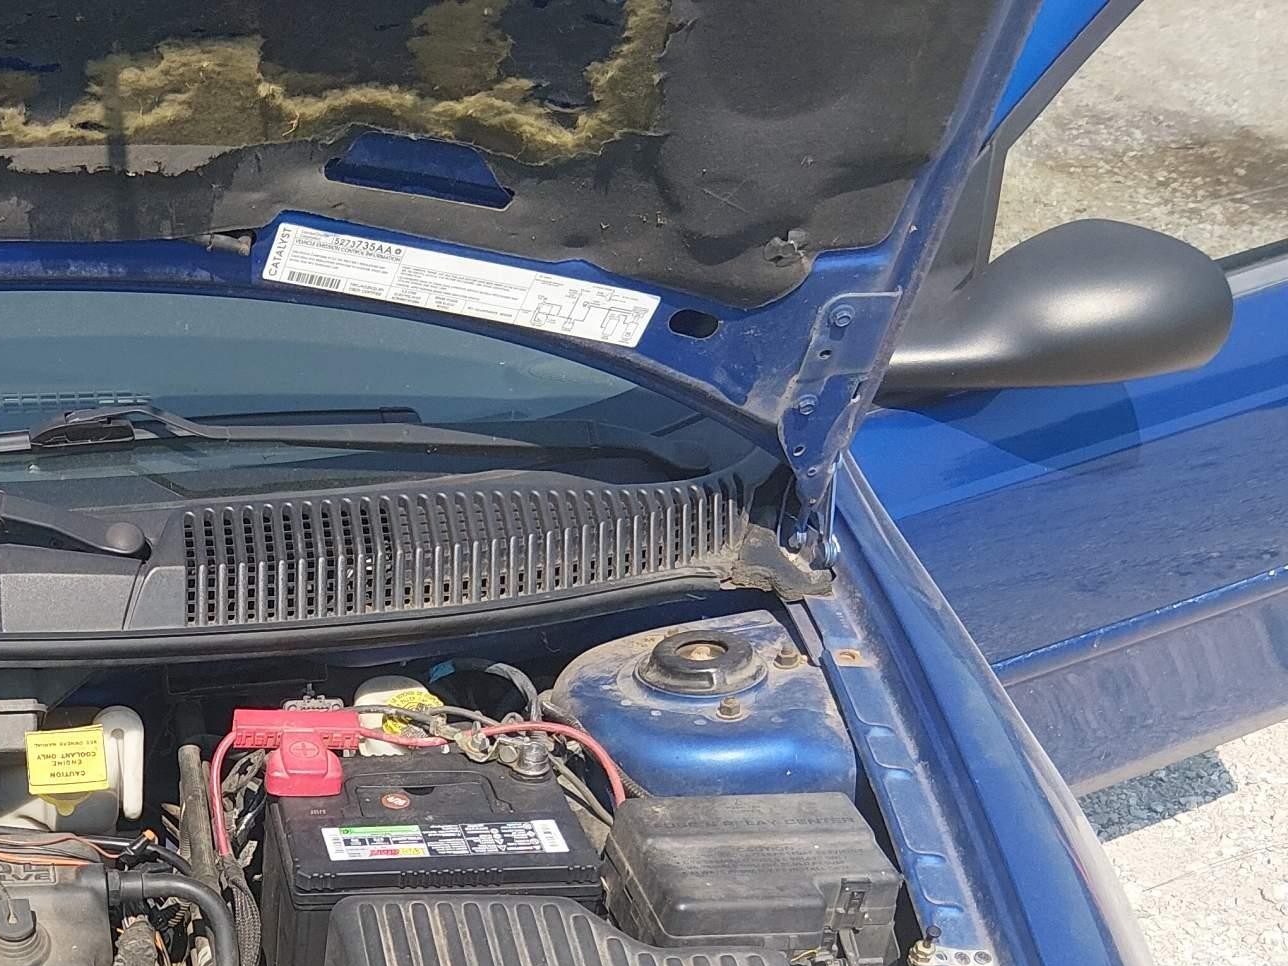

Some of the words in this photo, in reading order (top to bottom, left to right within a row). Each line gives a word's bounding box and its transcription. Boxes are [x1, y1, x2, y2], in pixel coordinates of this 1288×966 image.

[268, 228, 291, 276] CATALYST
[334, 238, 392, 254] 5273735AA
[50, 770, 86, 778] CAUTION
[786, 817, 855, 827] CENTER
